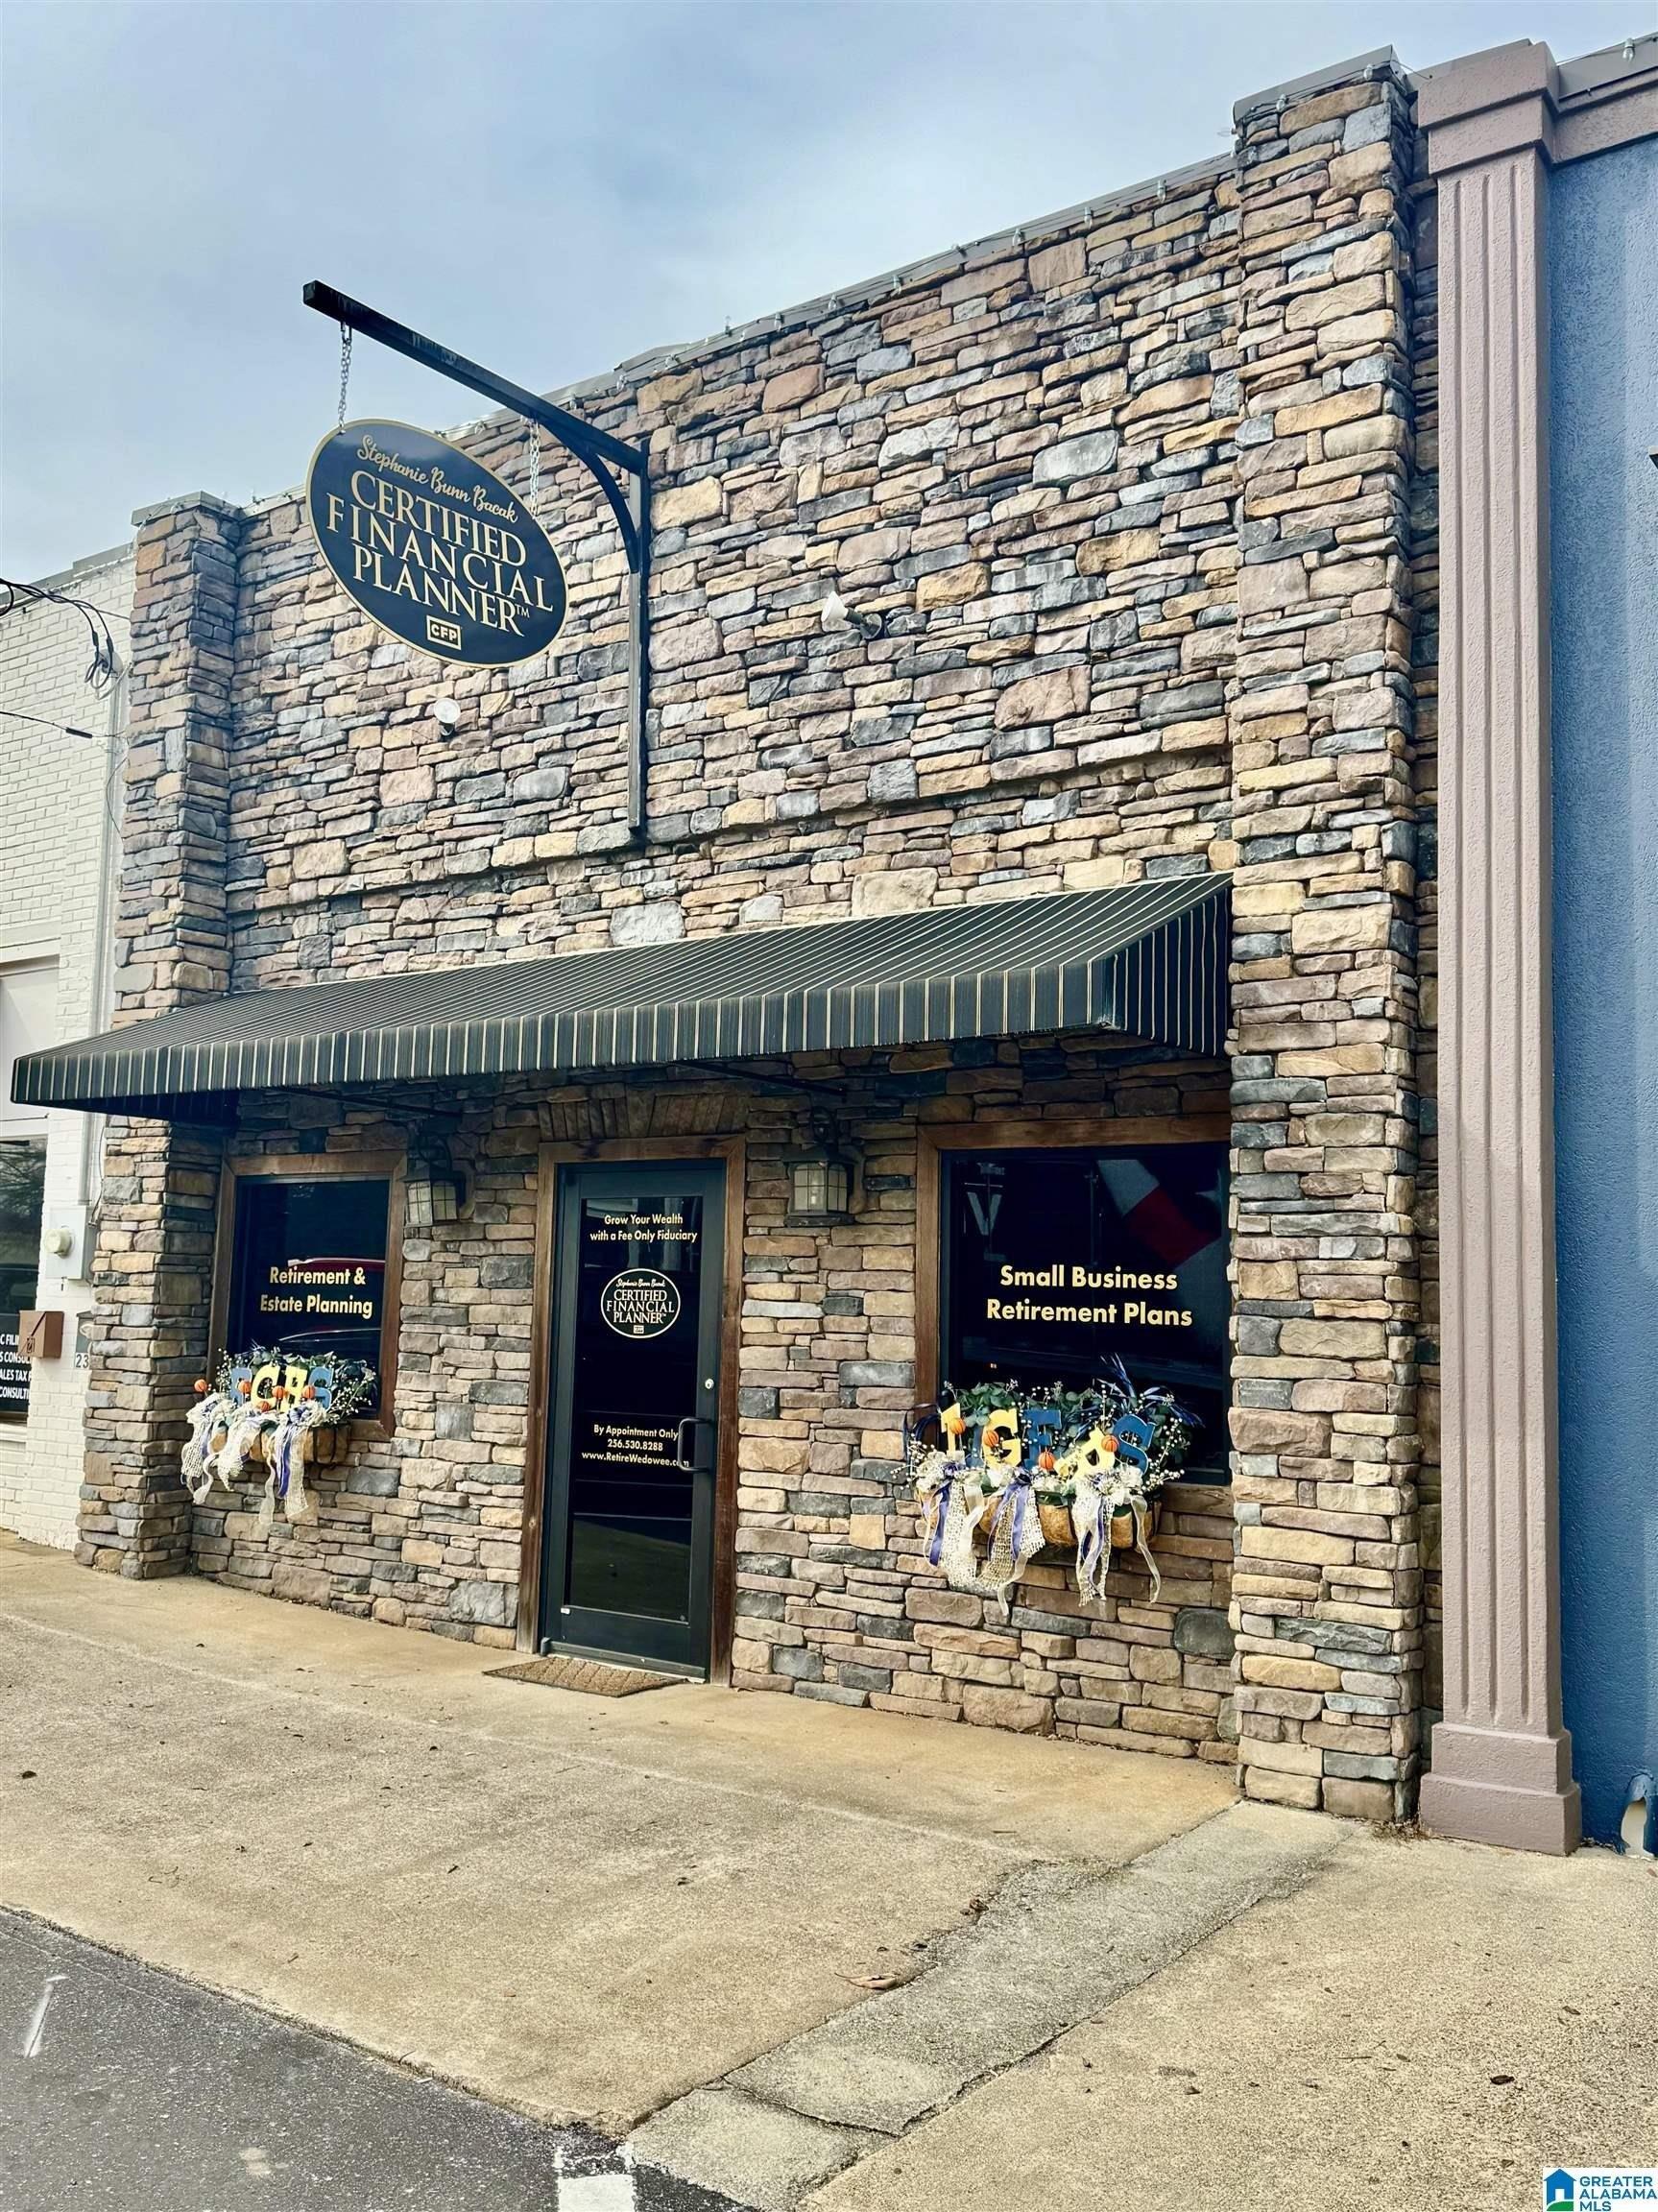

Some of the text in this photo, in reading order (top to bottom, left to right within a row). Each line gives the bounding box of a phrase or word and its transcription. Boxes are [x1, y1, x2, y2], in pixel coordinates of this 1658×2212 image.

[357, 435, 518, 523] Stephanie Bunn Bacak
[350, 469, 527, 568] CERTIFIED
[326, 493, 554, 612] FINANCIAL
[430, 623, 458, 640] CFP
[604, 1213, 684, 1225] Grow Your Wealth
[589, 1230, 609, 1240] with
[618, 1230, 633, 1240] Fee
[634, 1229, 655, 1243] Only
[657, 1229, 698, 1242] Fiduciary
[270, 1266, 366, 1286] Retirement &
[1000, 1264, 1178, 1290] Small Business
[613, 1289, 667, 1302] CERTIFIED
[260, 1294, 372, 1319] Estate Planning
[606, 1300, 675, 1313] FINANCIAL
[987, 1298, 1192, 1327] Retirement Plans
[75, 1353, 90, 1368] 23
[15, 1370, 27, 1382] TAX
[593, 1424, 679, 1441] By Appointment Only
[607, 1439, 663, 1452] 256.530.8288
[582, 1452, 689, 1468] www.RetireWedowee.cm
